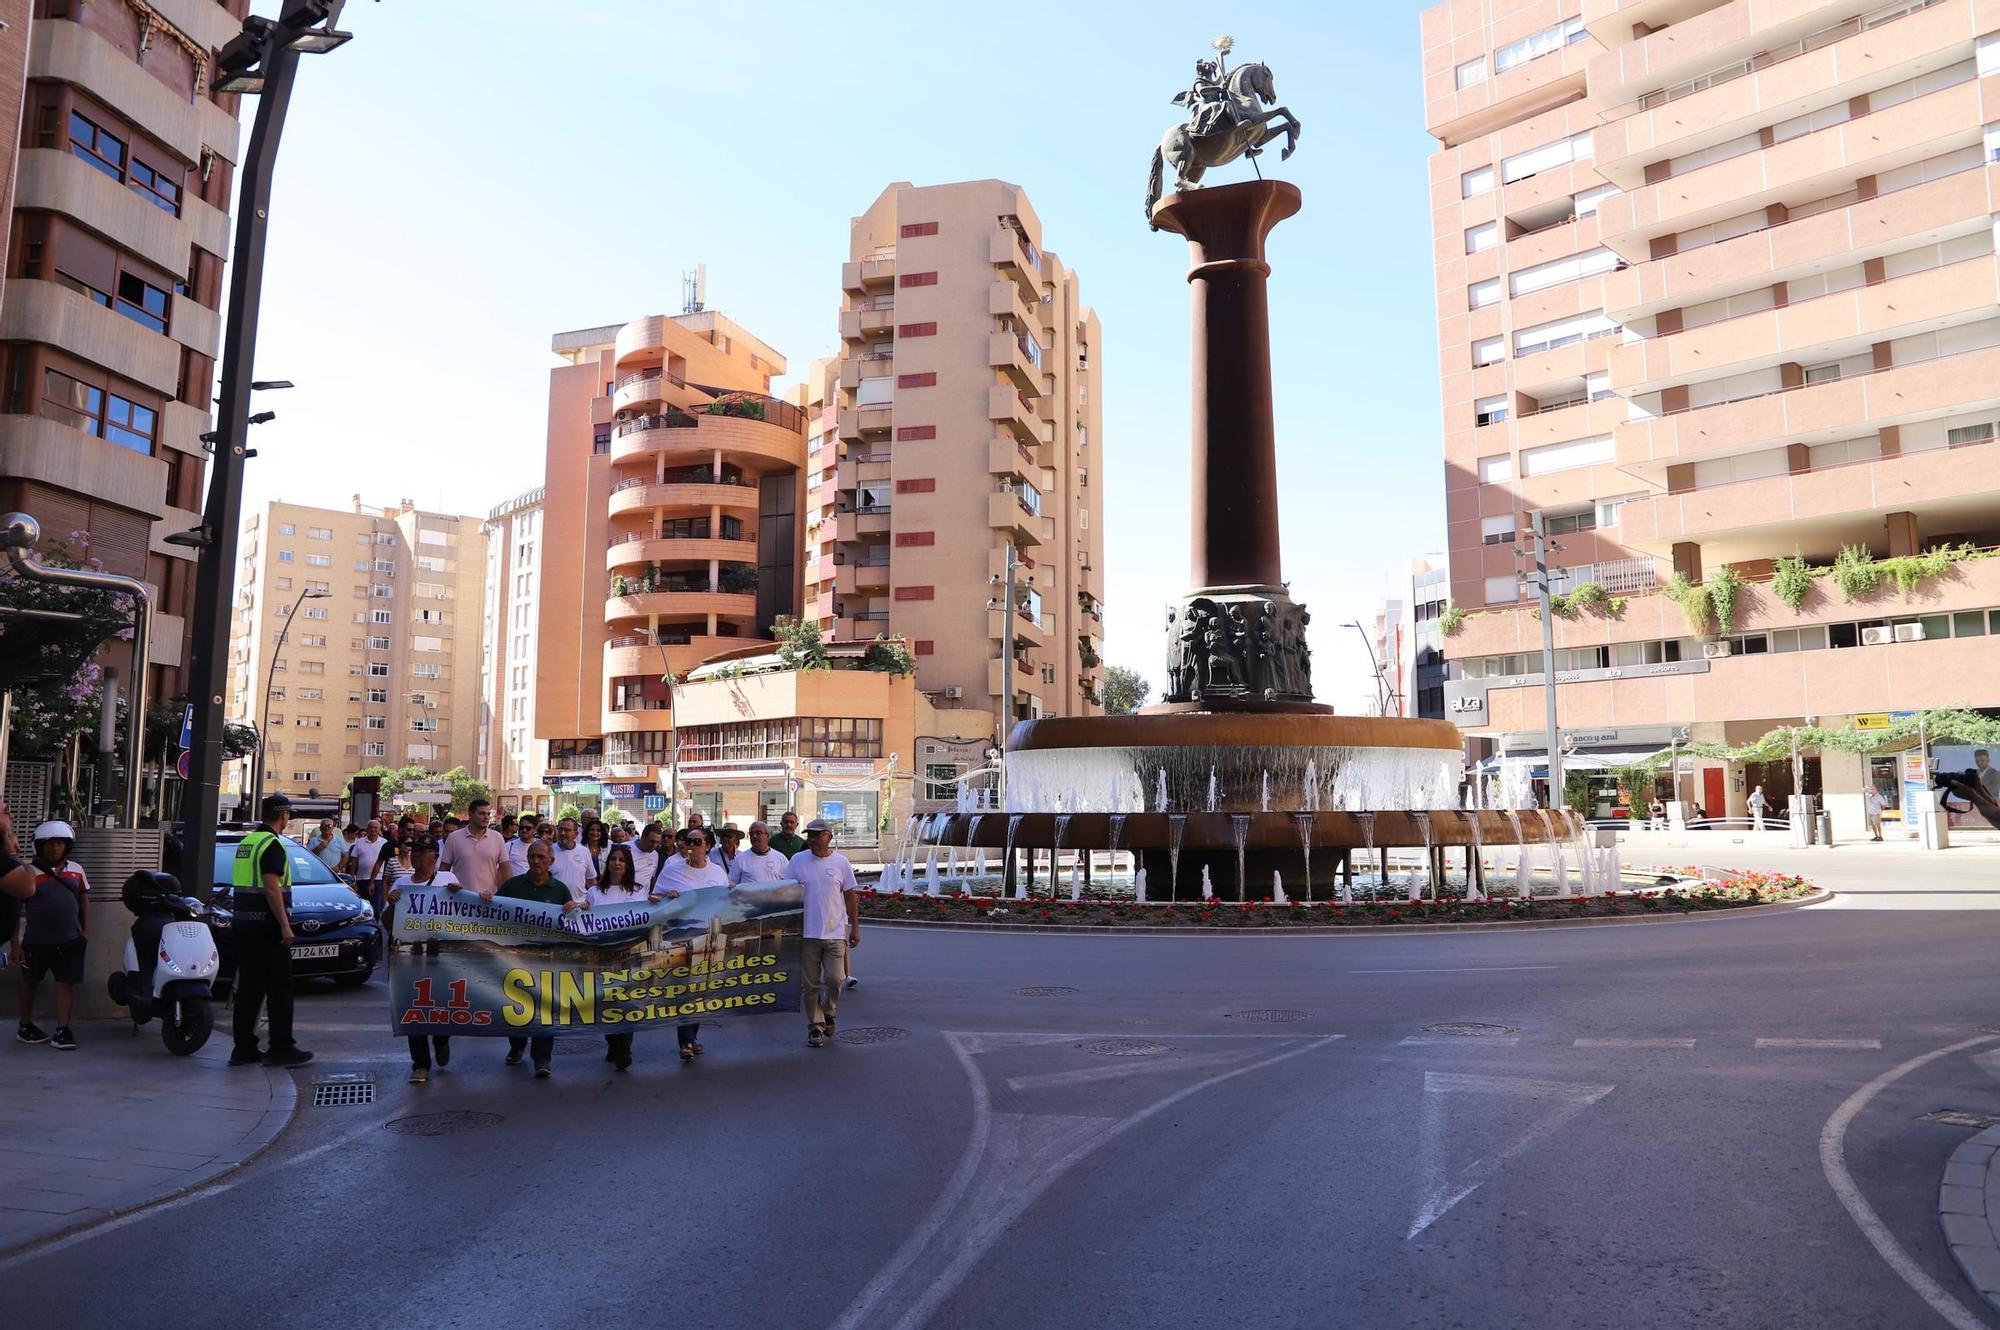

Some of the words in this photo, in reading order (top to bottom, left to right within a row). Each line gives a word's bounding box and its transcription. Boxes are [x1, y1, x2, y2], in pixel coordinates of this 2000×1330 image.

[1451, 695, 1481, 710] alza
[1565, 732, 1593, 742] anco
[1594, 735, 1600, 743] y
[1600, 731, 1618, 741] azul
[611, 784, 635, 794] AUSTRO
[407, 893, 426, 915] XI
[427, 893, 510, 922] Aniversario
[514, 906, 552, 929] Riada
[556, 911, 581, 934] San
[580, 909, 650, 934] Wenceslao
[404, 918, 422, 931] 28
[425, 919, 442, 932] de
[445, 920, 518, 937] Septiembre
[291, 947, 316, 957] 7124
[318, 946, 337, 956] KKY
[600, 953, 777, 985] Novedades
[502, 967, 596, 1027] SIN
[600, 971, 788, 1003] Respuestas
[400, 1006, 493, 1026] AÑOS
[600, 991, 777, 1025] Soluciones
